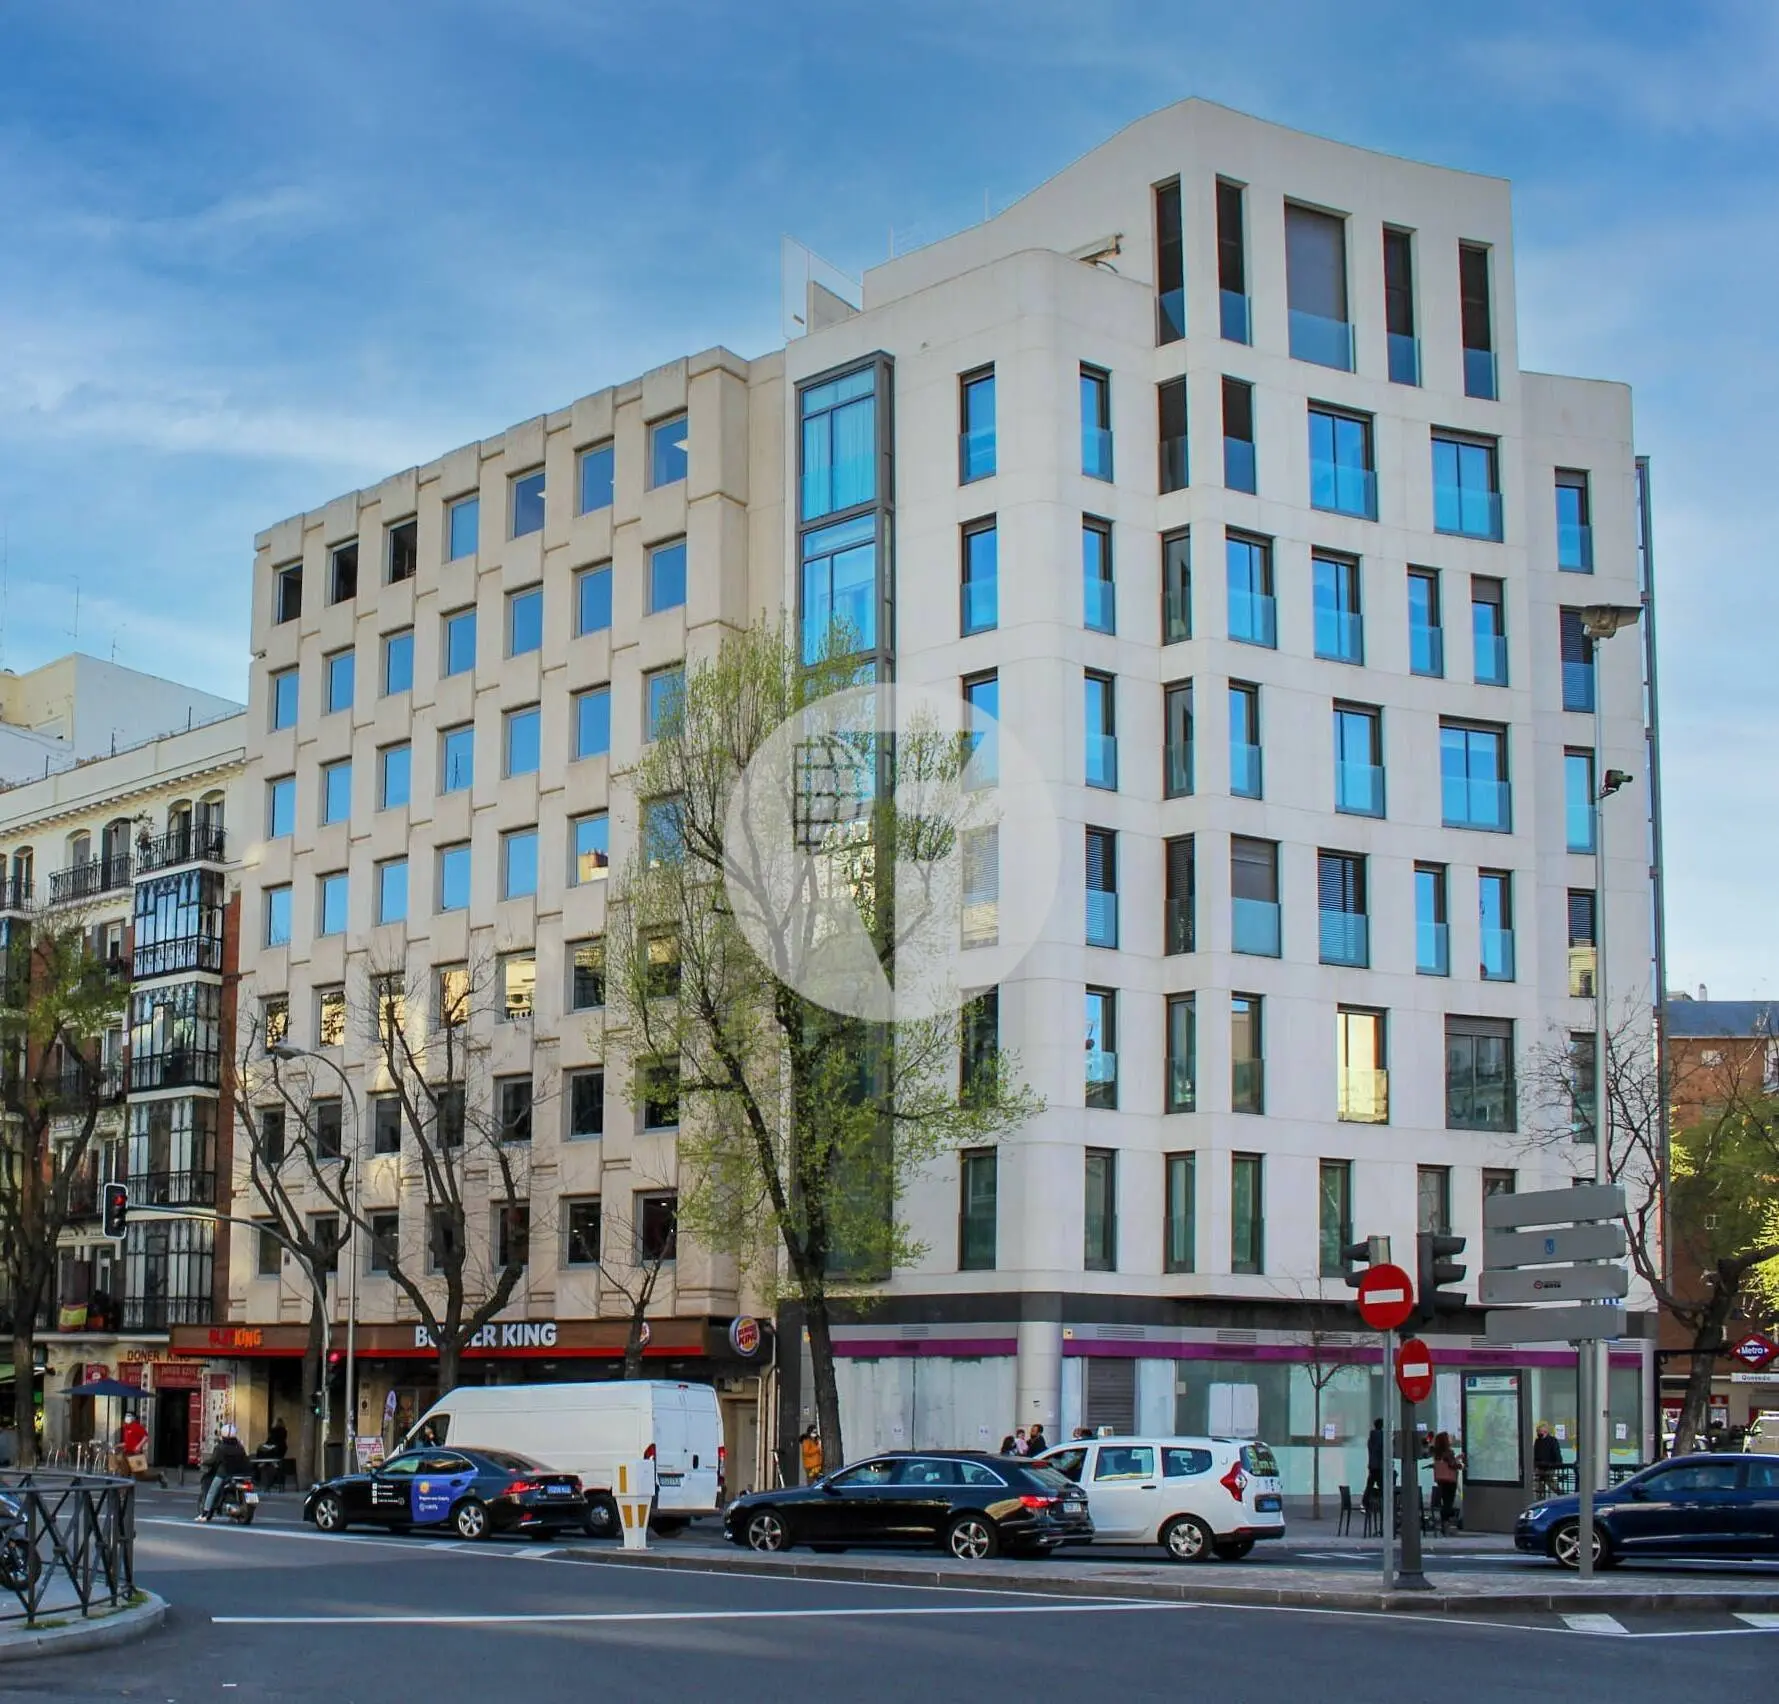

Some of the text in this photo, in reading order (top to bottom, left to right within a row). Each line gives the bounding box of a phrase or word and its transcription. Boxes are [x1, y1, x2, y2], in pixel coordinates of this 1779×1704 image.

[415, 1323, 557, 1347] BER KING
[1741, 1346, 1764, 1355] Metro
